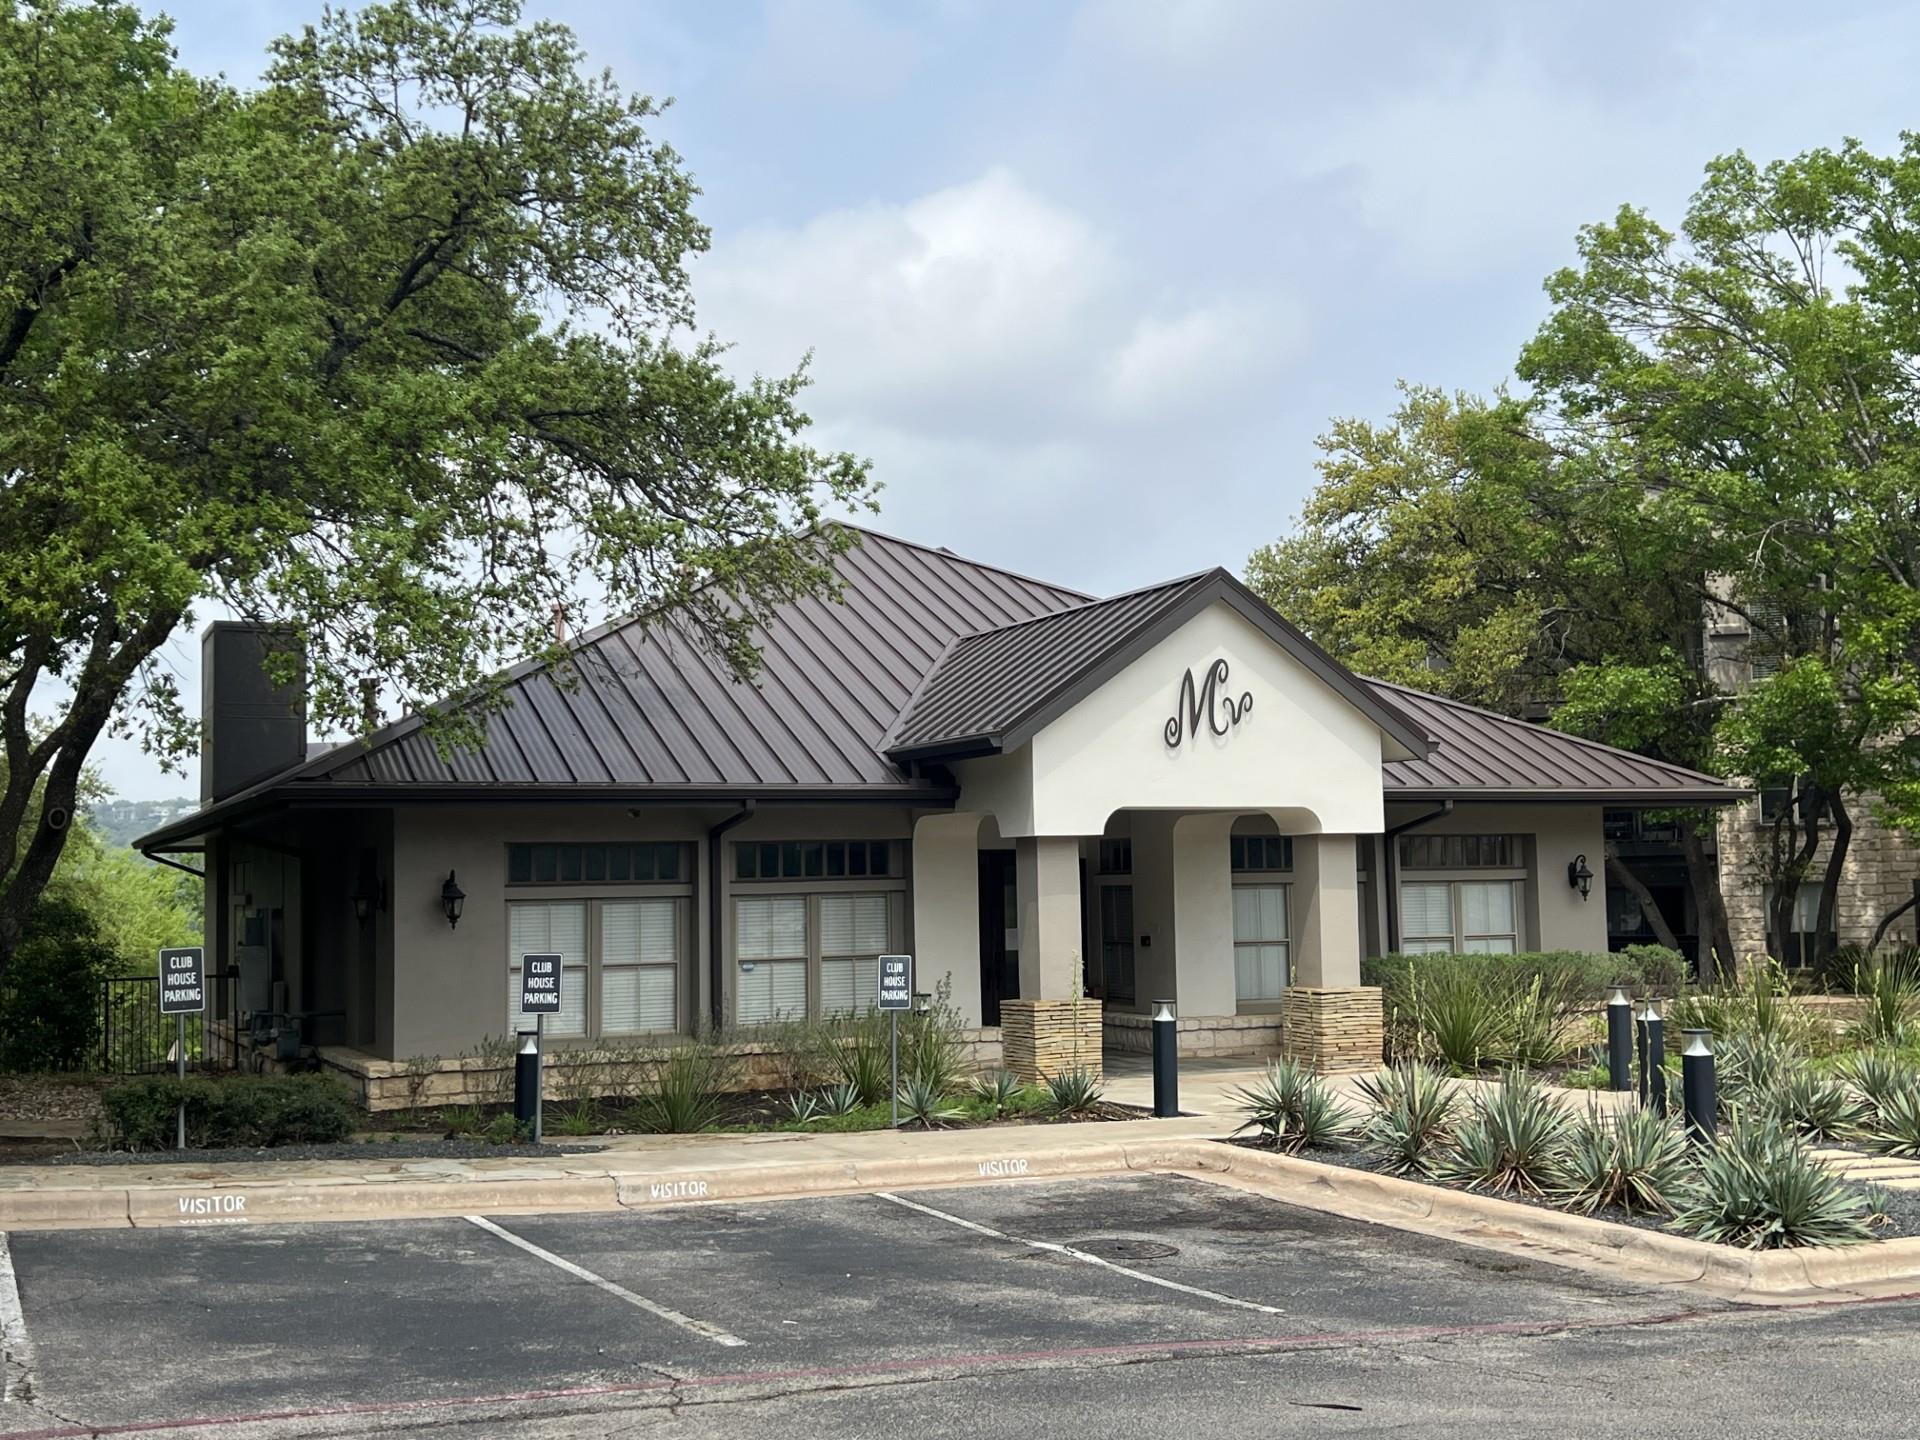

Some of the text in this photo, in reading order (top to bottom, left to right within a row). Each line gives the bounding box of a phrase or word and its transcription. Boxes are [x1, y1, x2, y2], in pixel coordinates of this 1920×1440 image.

[170, 956, 193, 969] CLUB
[531, 961, 552, 973] CLUB
[886, 962, 904, 973] CLUB
[167, 972, 197, 986] HOUSE
[527, 977, 555, 989] HOUSE
[883, 976, 906, 987] HOUSE
[164, 988, 201, 1003] PARKING
[524, 992, 558, 1004] PARKING
[881, 990, 908, 1001] PARKING
[978, 1159, 1029, 1176] VISITOR
[650, 1181, 708, 1199] VISITOR
[179, 1195, 246, 1214] VISITOR
